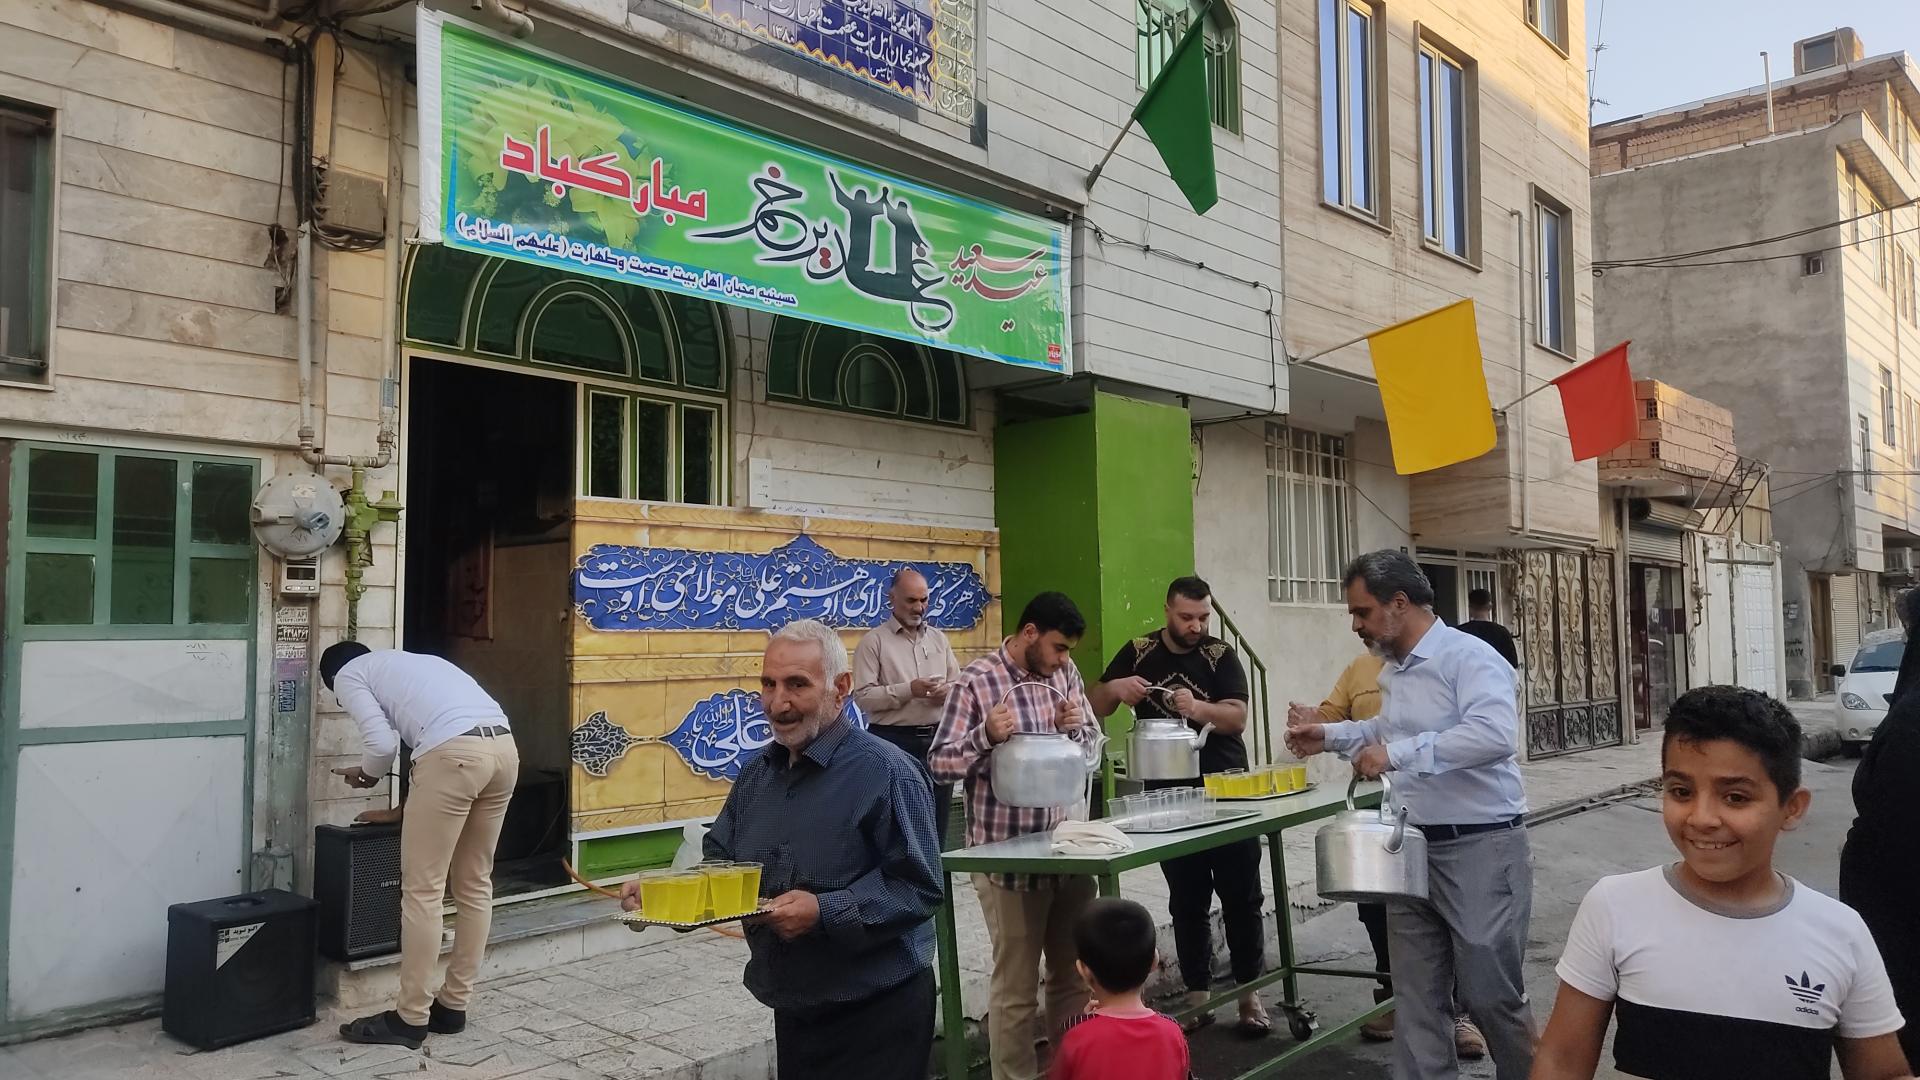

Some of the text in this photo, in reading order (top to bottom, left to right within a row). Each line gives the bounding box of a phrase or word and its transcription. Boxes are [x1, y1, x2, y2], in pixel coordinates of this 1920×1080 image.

[772, 24, 797, 44] ۱۳۸۰
[816, 16, 857, 36] عصمت
[691, 165, 806, 252] خم
[629, 257, 669, 277] عصمت
[672, 267, 697, 286] بیت
[701, 271, 722, 289] اهل
[725, 277, 755, 298] محبان
[758, 288, 797, 306] حسینیه
[652, 563, 738, 615] مولای
[735, 565, 783, 619] علی
[760, 564, 869, 620] هستم
[926, 568, 968, 618] که
[811, 591, 840, 617] او
[945, 590, 974, 618] هر
[1795, 1006, 1819, 1016] adidas
